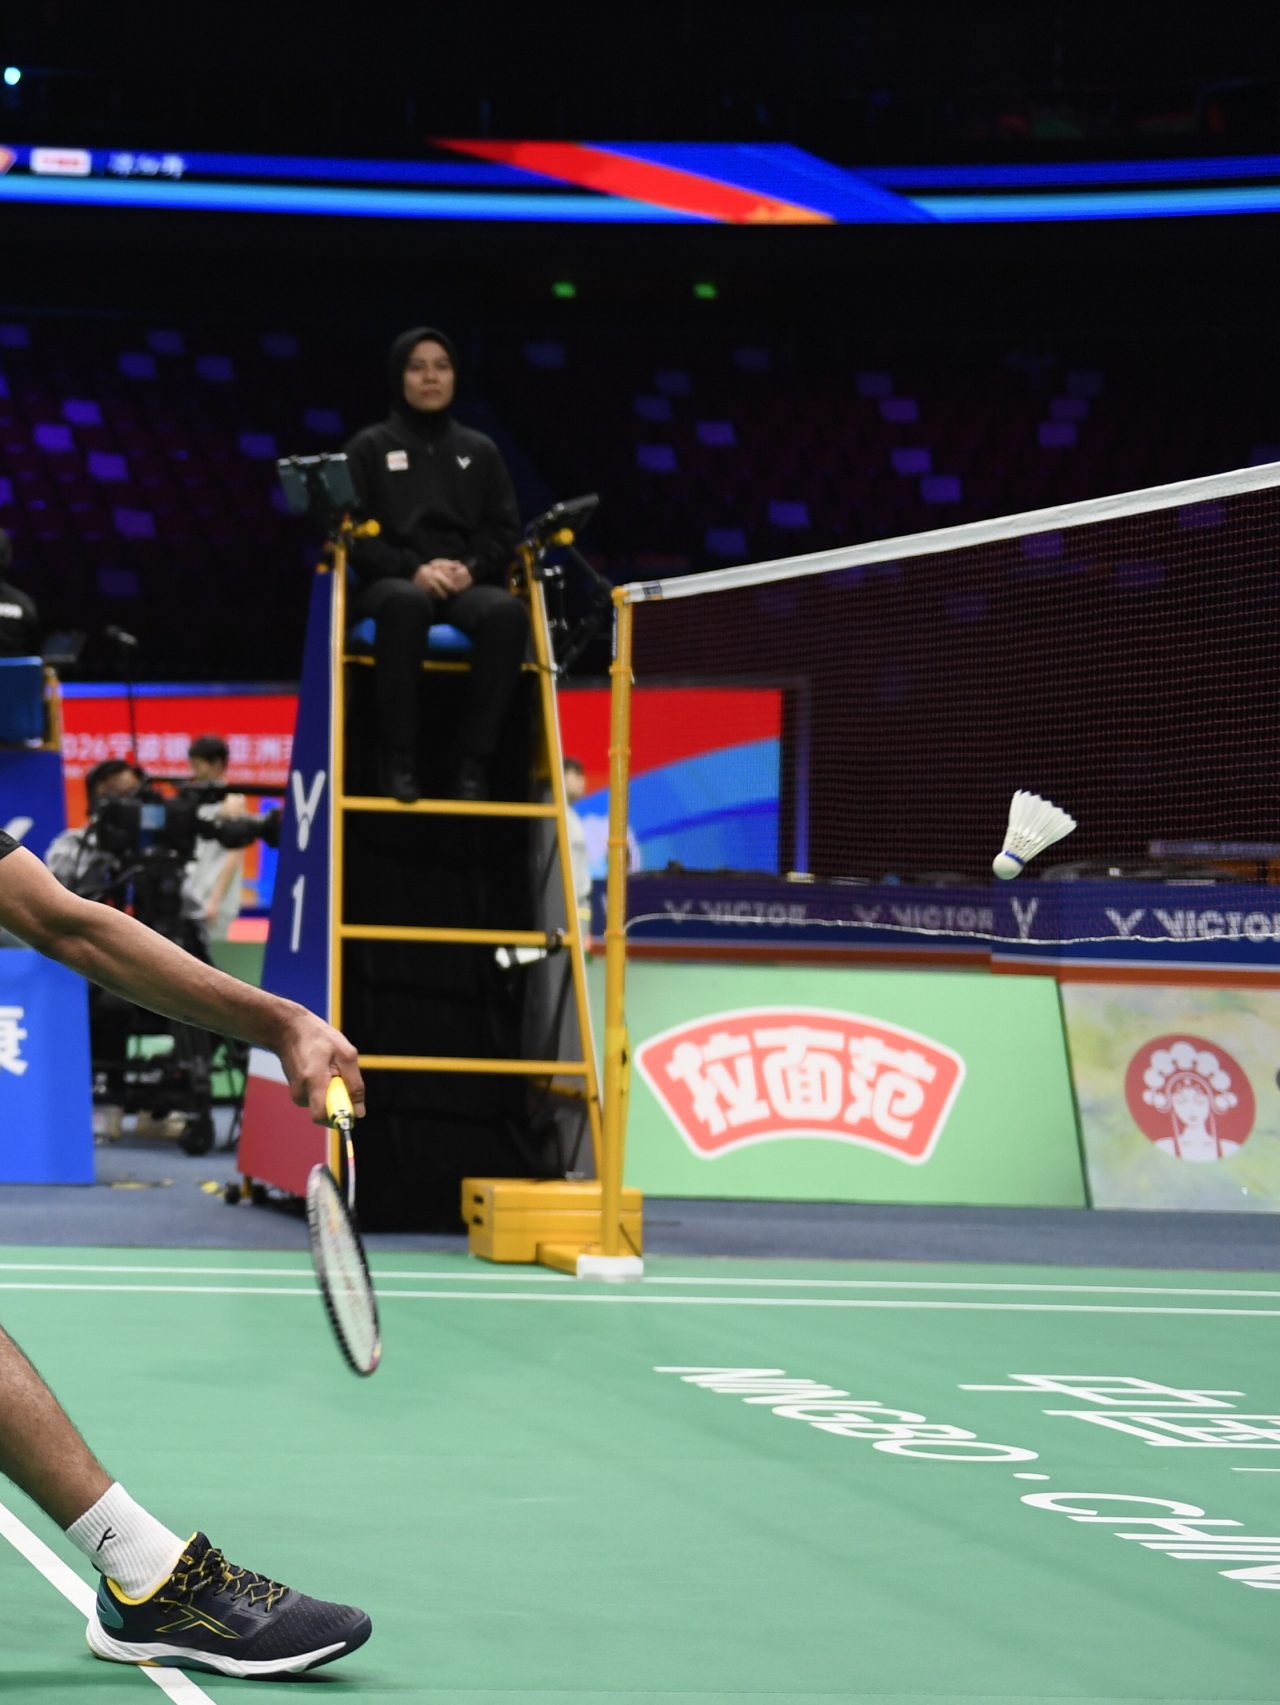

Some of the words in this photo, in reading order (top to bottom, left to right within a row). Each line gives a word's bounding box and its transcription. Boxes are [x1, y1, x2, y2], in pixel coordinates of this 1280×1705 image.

[700, 900, 808, 925] VICTOR
[890, 904, 994, 930] VICTOR
[1152, 908, 1280, 943] VICTO
[665, 1025, 937, 1140] 拉面范
[653, 1366, 1040, 1462] NINGBO
